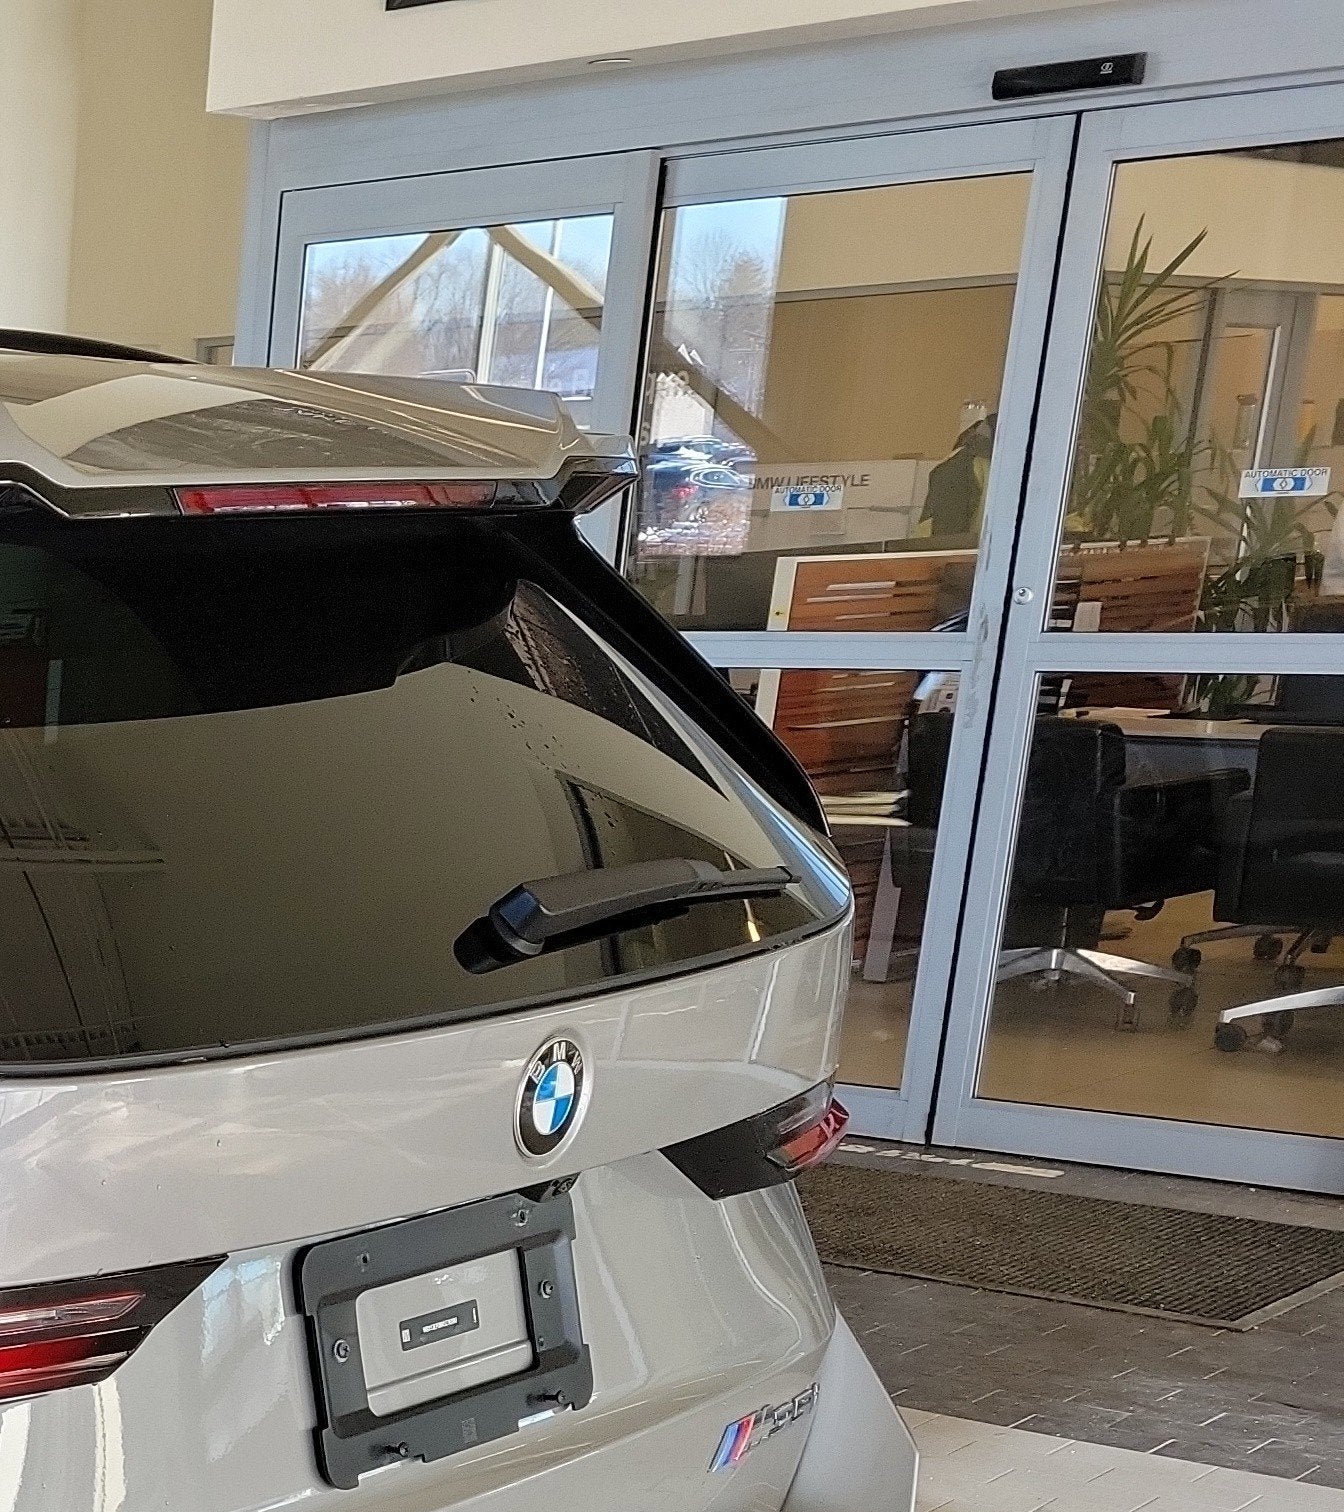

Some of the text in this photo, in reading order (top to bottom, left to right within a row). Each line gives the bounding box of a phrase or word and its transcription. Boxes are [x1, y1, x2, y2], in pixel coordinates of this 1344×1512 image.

[1244, 468, 1328, 479] AUTOMATIC DOOR
[774, 485, 842, 495] AUTOMATIC DOOR
[530, 1041, 583, 1084] BMW
